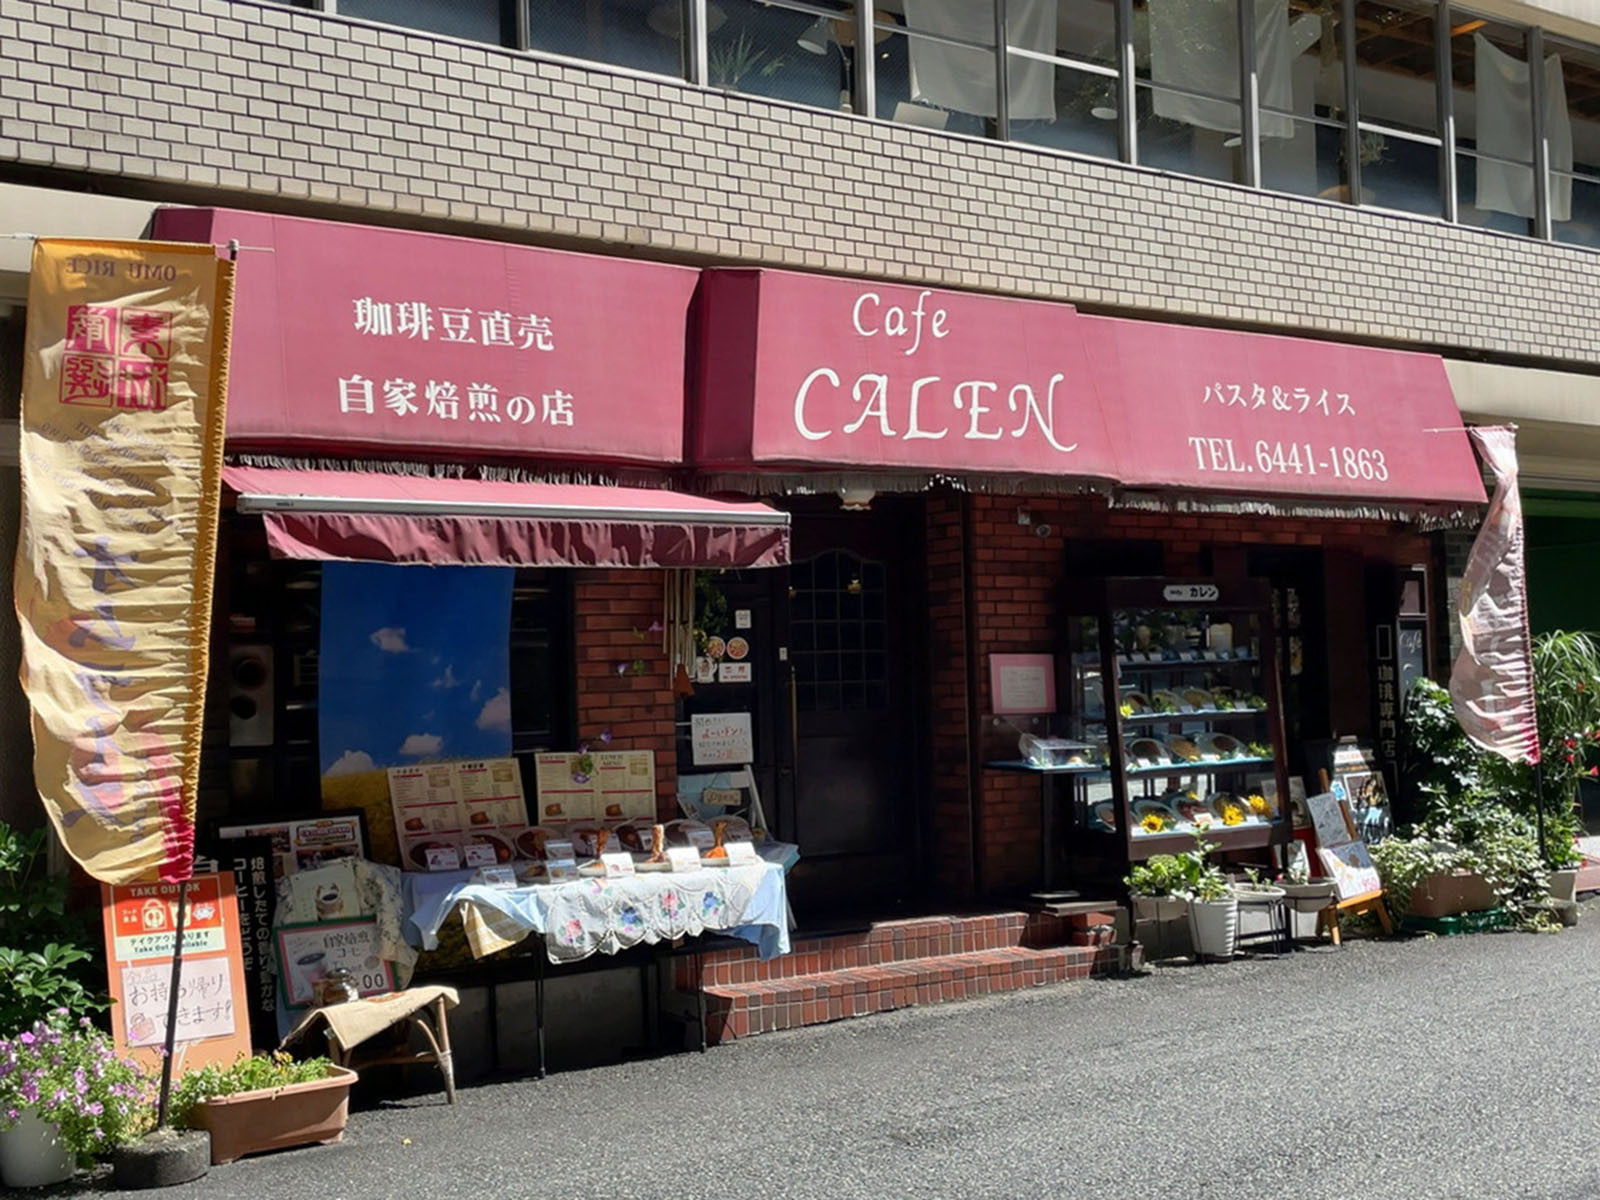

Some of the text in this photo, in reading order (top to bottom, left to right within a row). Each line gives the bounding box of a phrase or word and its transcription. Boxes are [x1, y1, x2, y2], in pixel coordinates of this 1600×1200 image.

[352, 296, 556, 353] 珈琲豆直売
[852, 290, 949, 356] Cafe
[338, 375, 575, 427] 自家焙煎の店
[795, 367, 1078, 453] CALEN
[1202, 381, 1357, 417] パスタ&ライス
[1189, 586, 1217, 598] カレン
[130, 886, 159, 897] TAKE
